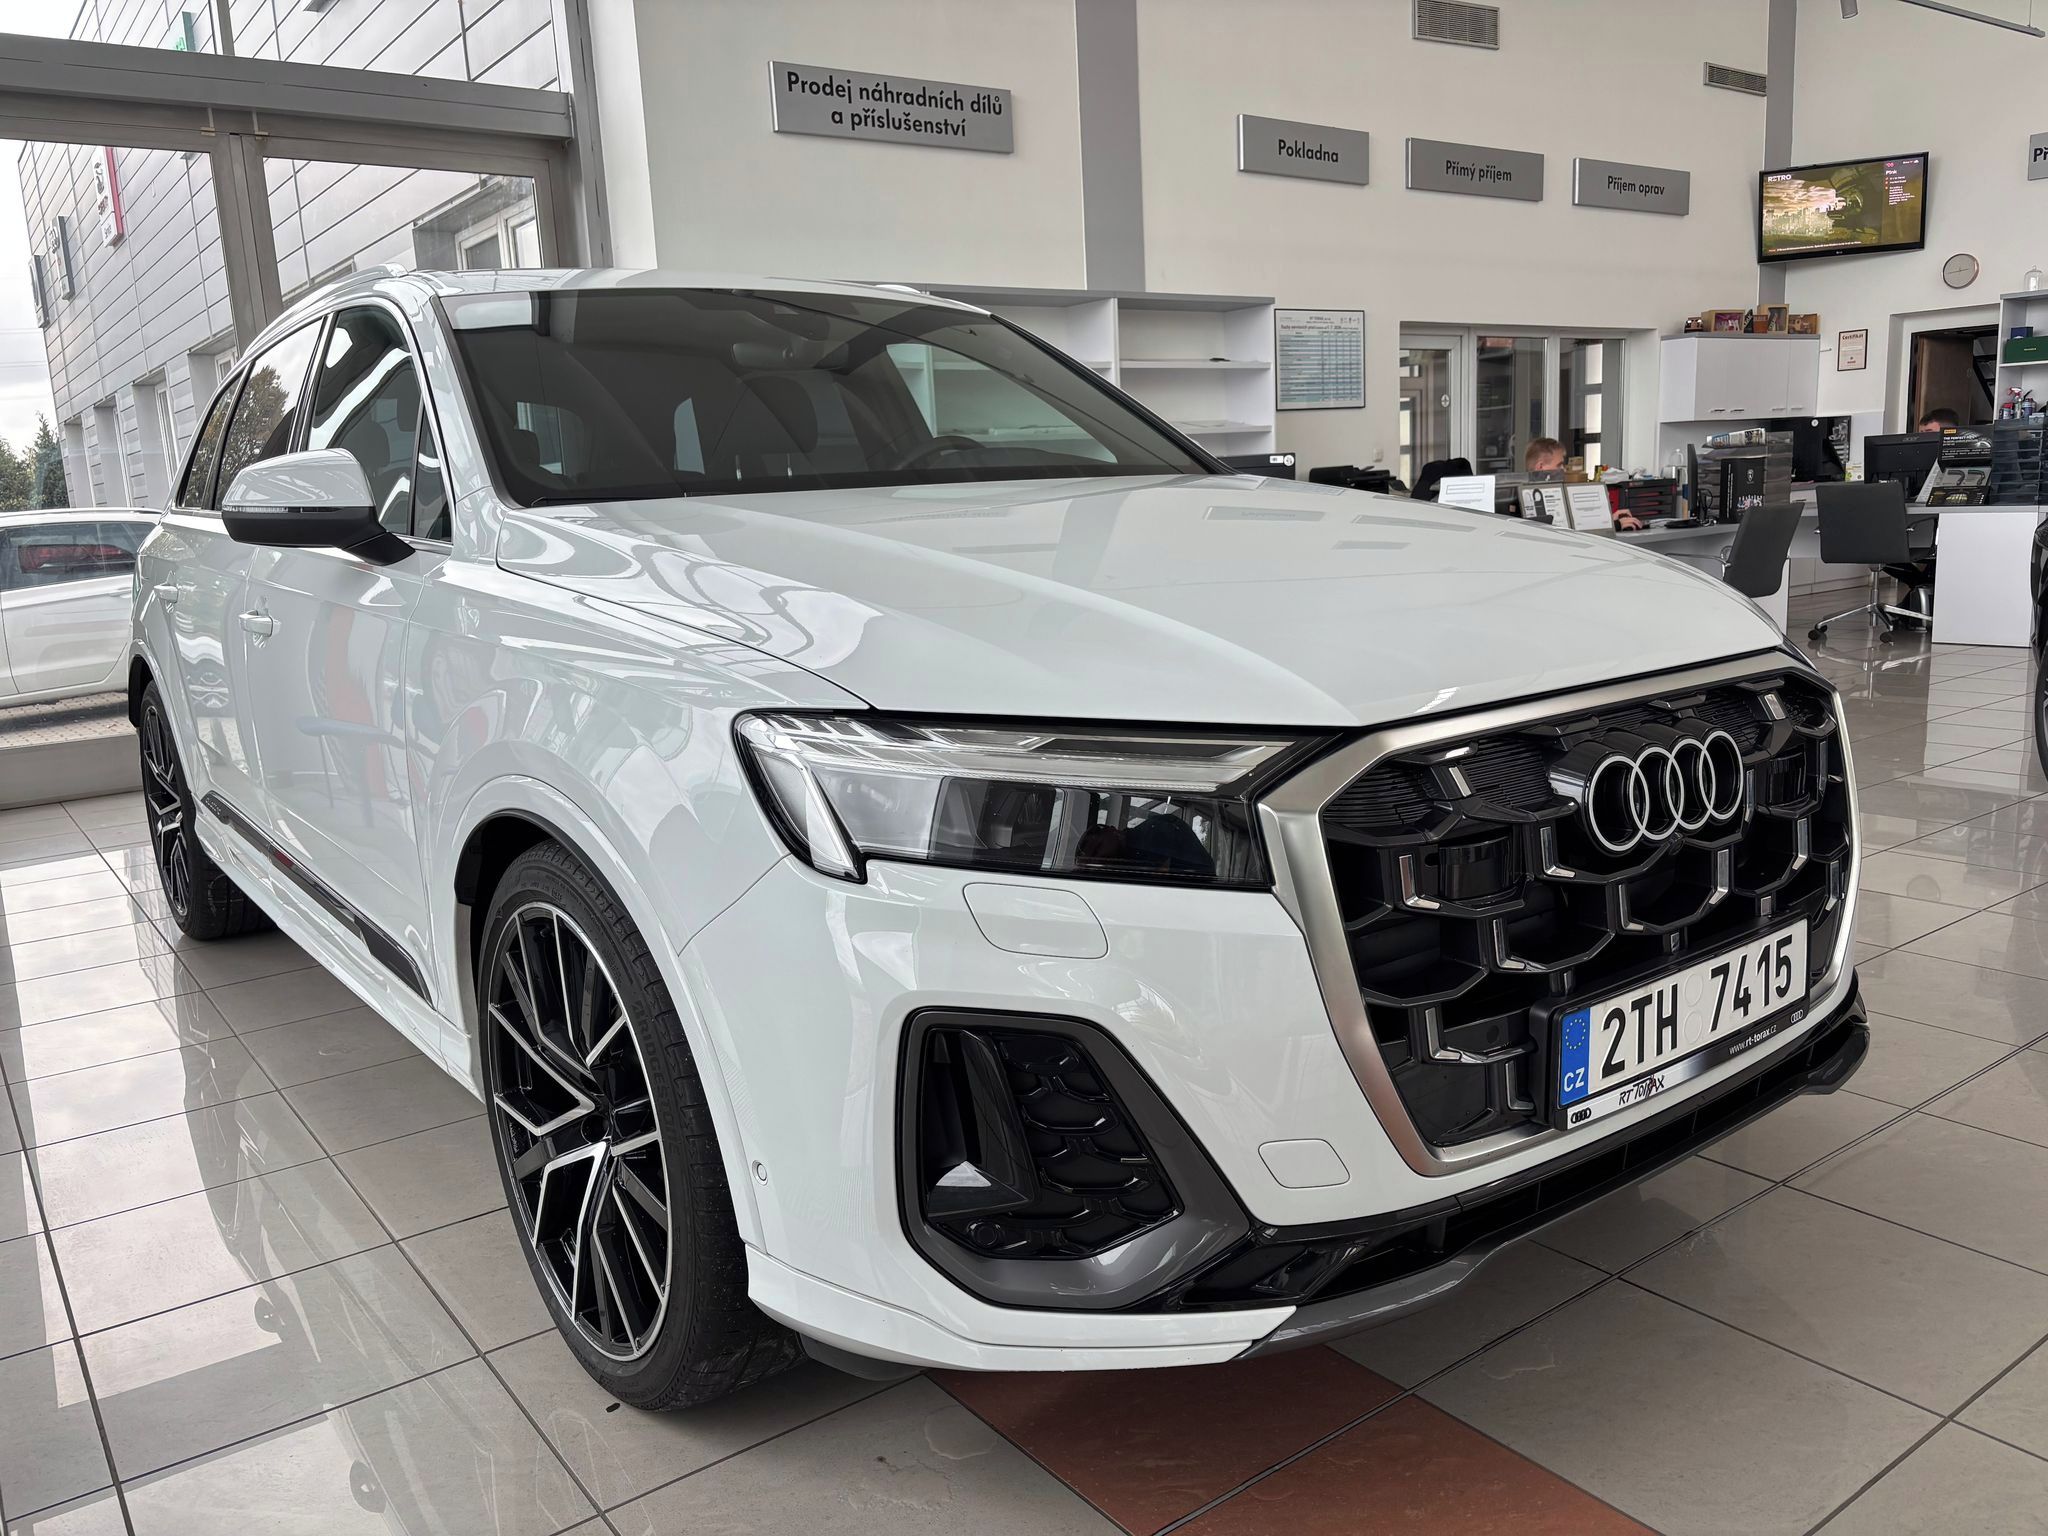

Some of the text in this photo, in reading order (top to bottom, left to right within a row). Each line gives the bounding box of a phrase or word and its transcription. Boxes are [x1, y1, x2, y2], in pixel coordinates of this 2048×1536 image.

[787, 71, 1003, 116] Prodej náhradních dílů
[831, 107, 966, 137] a příslušenství
[1278, 139, 1339, 163] Pokladna
[1445, 160, 1512, 184] Přímý příjem
[1638, 184, 1665, 197] oprav
[1601, 934, 1793, 1079] 2TH 7415
[1729, 1024, 1777, 1055] www.rt-torax.cz
[1564, 1067, 1585, 1093] CZ
[1619, 1089, 1633, 1106] RT
